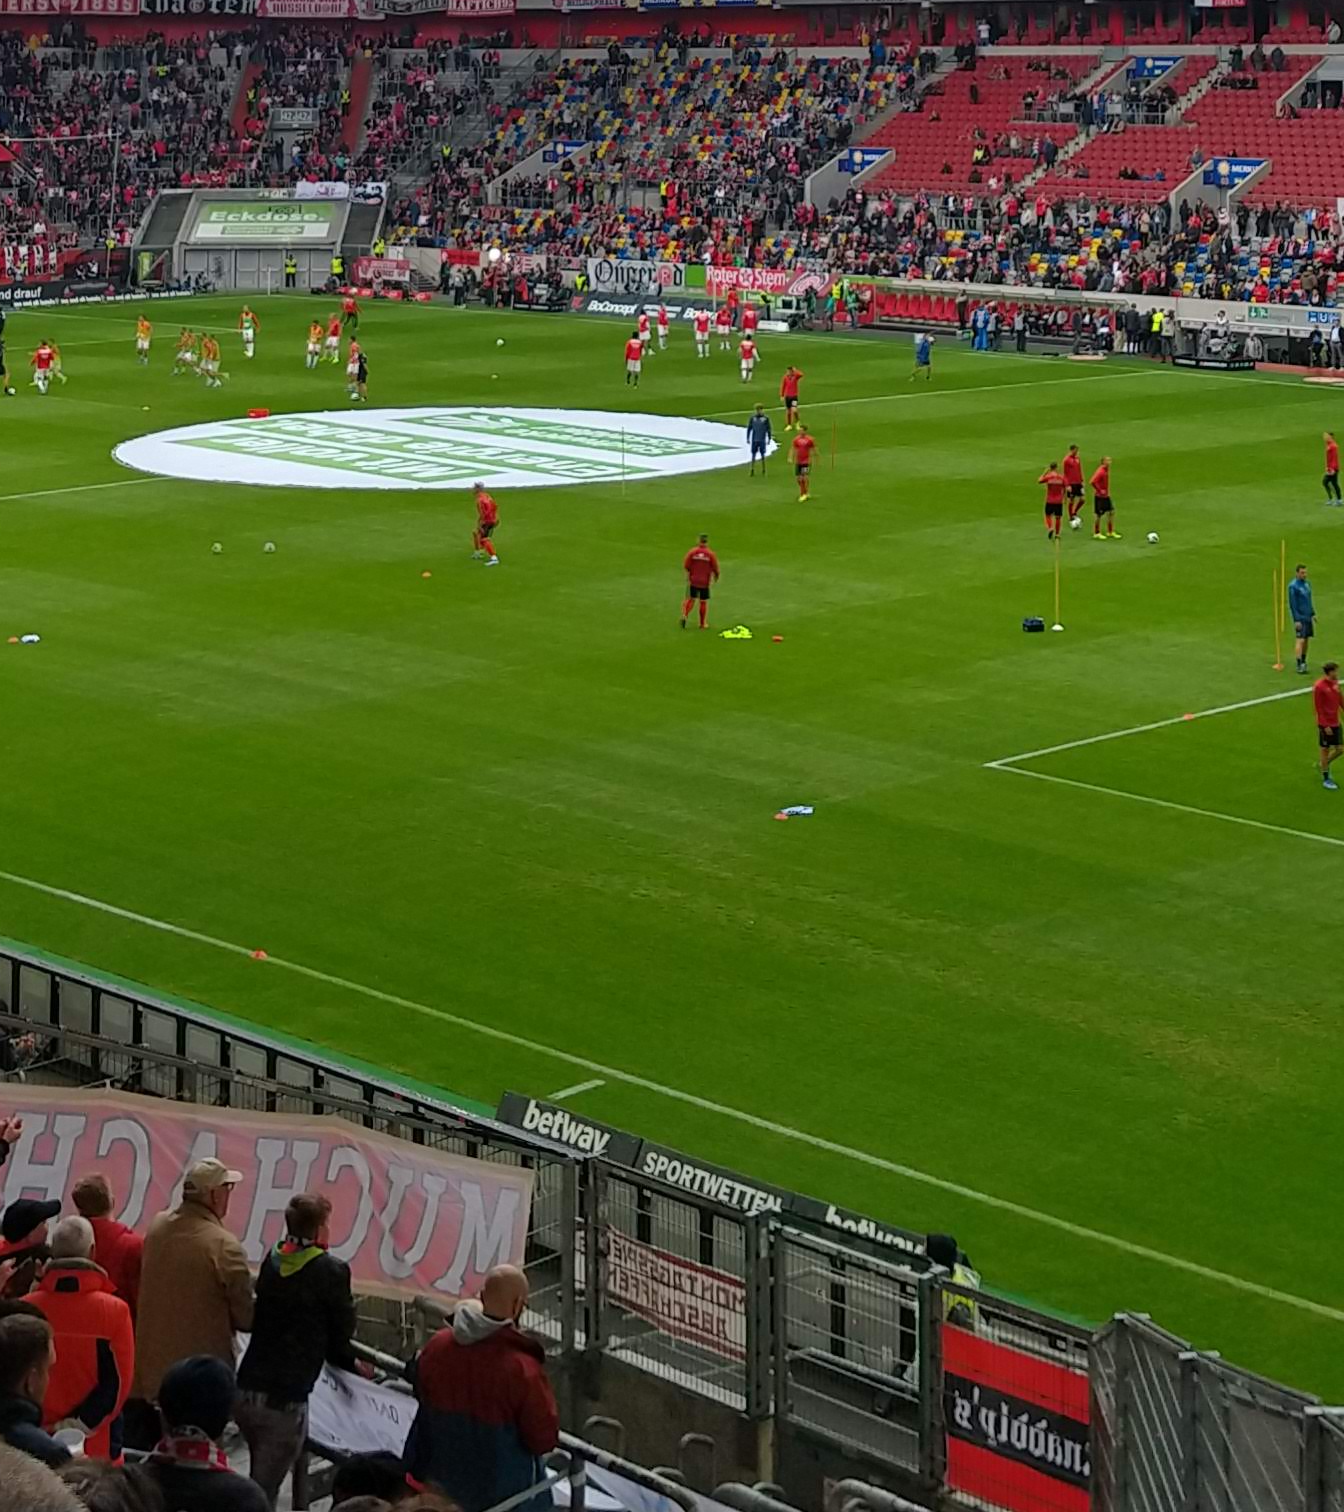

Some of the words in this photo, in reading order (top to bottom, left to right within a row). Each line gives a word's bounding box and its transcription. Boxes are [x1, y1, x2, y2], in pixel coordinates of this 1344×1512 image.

[210, 210, 325, 222] Eckdose.
[707, 266, 738, 284] Roter
[14, 287, 42, 299] drauf
[587, 300, 638, 316] BoConcept
[205, 435, 367, 465] voller
[404, 441, 630, 478] Energie
[522, 1099, 611, 1155] betway
[642, 1150, 783, 1216] SPORTWETTEN
